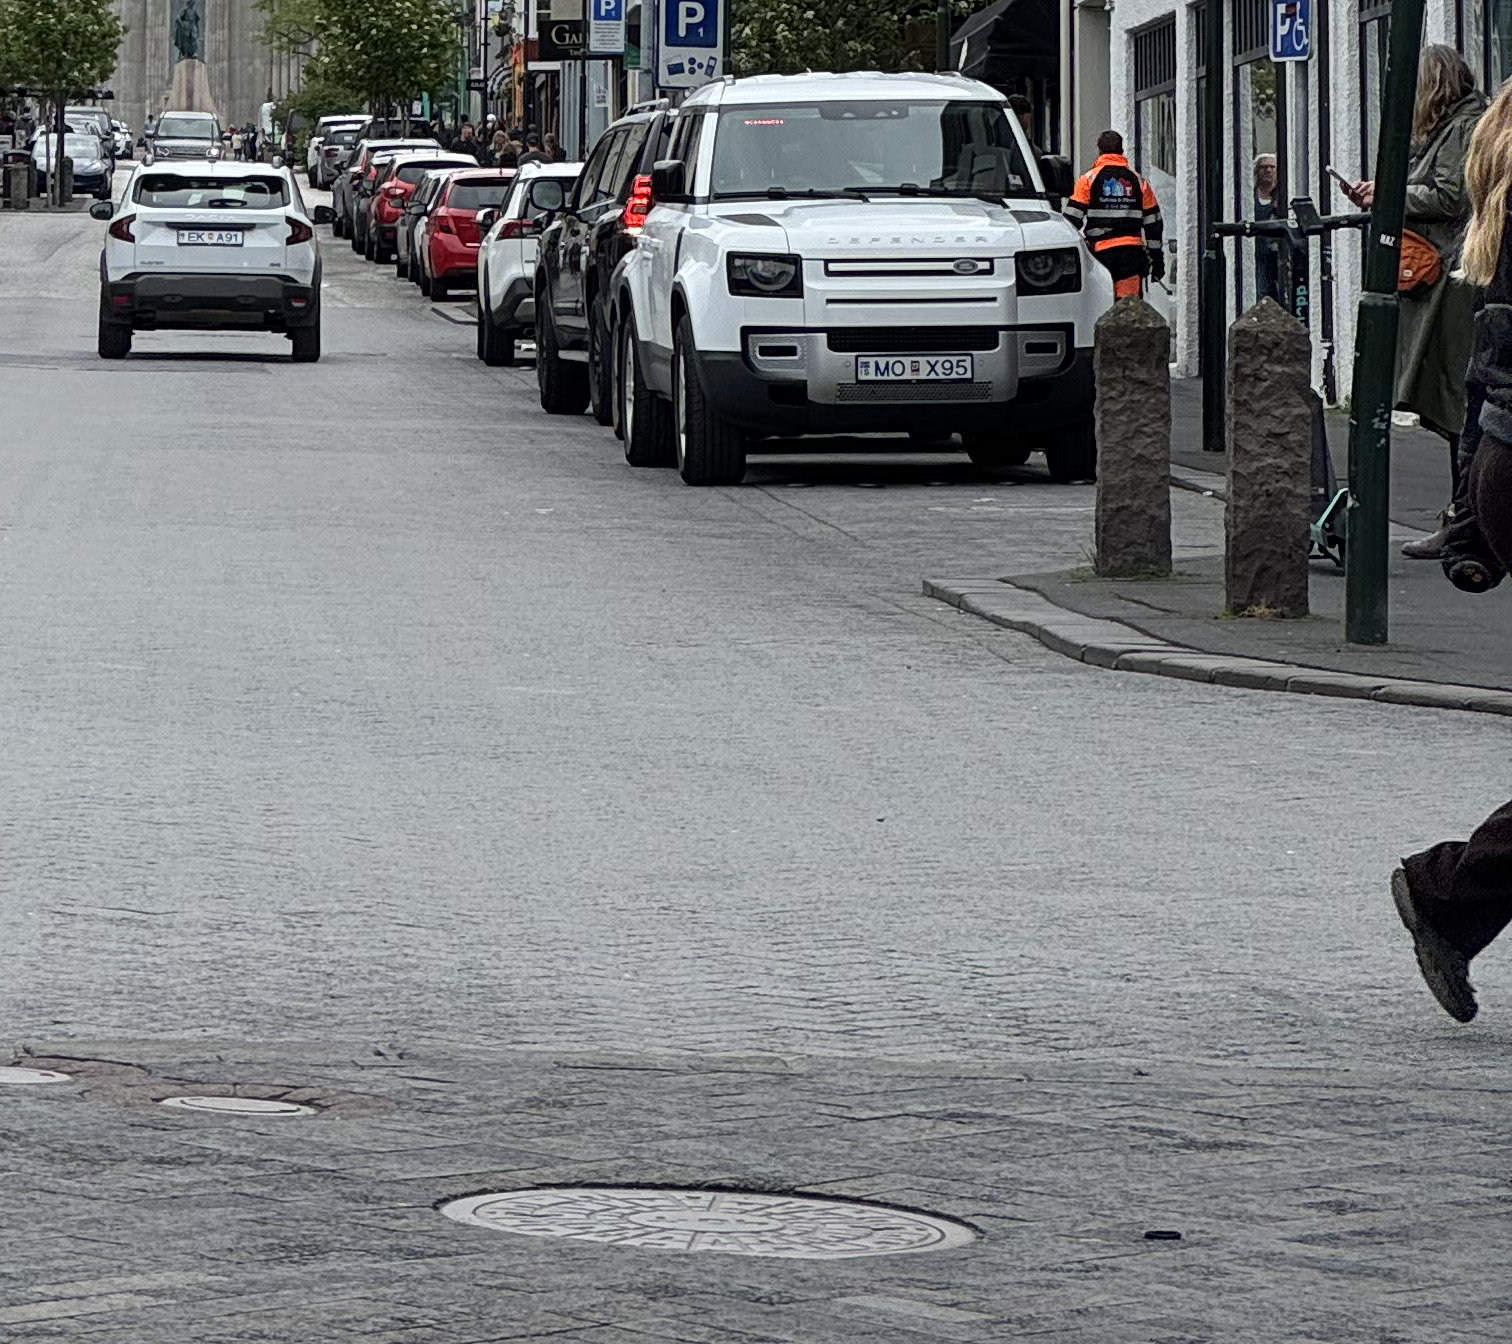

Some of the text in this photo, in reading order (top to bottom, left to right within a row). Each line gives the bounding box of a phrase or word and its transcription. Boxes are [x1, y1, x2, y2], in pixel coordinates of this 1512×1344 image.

[678, 1, 705, 38] P 1
[1276, 3, 1291, 53] P
[187, 232, 239, 243] EK A91
[826, 236, 988, 245] DEFENDER
[874, 360, 906, 377] MO
[925, 359, 968, 377] X95
